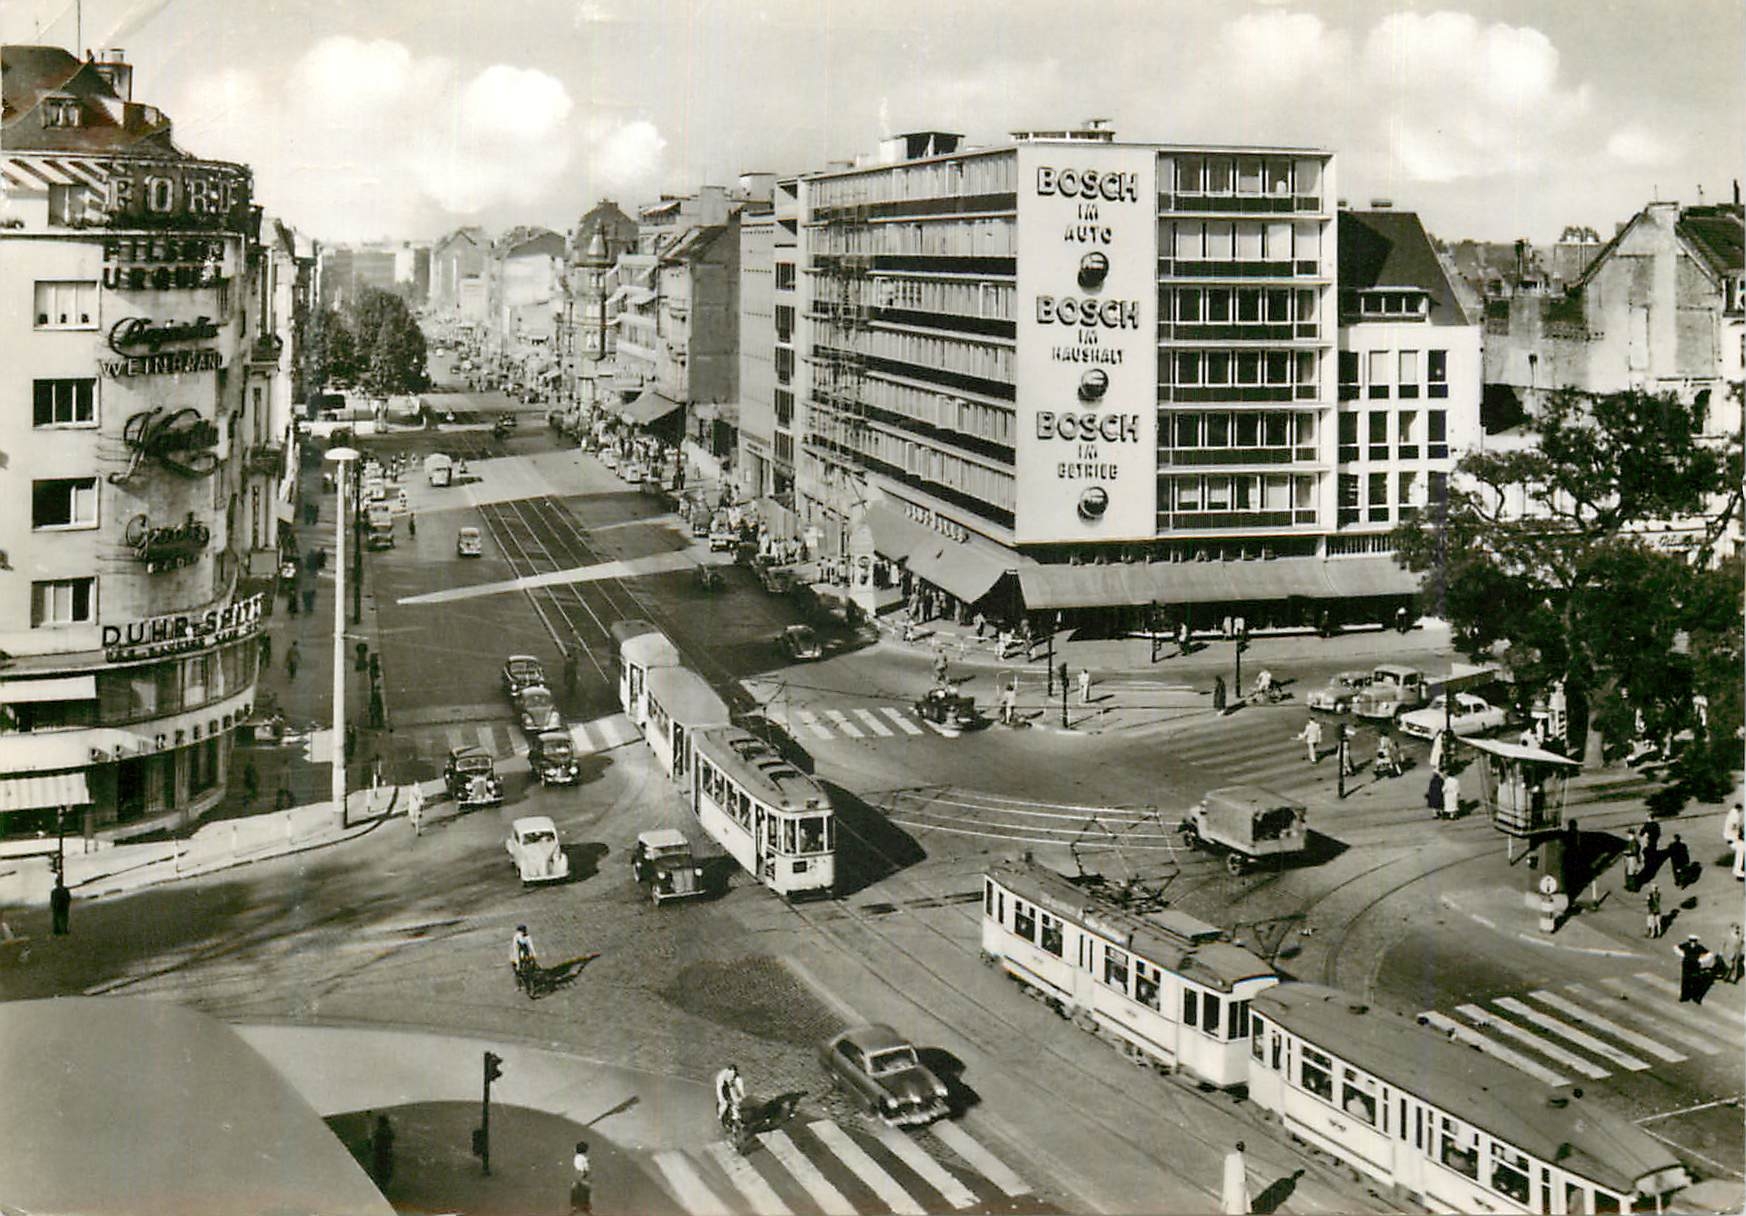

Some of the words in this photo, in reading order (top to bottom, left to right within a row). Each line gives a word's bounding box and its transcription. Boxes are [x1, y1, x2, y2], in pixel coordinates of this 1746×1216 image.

[1037, 166, 1138, 202] BOSCH
[1078, 203, 1098, 220] IM
[1064, 225, 1112, 244] AUTO
[1036, 295, 1139, 329] BOSCH
[1078, 329, 1098, 345] IM
[1052, 347, 1123, 365] HAUSHALT
[1036, 411, 1139, 443] BOSCH
[1078, 444, 1098, 460] IM
[1057, 462, 1118, 480] BETRIEB
